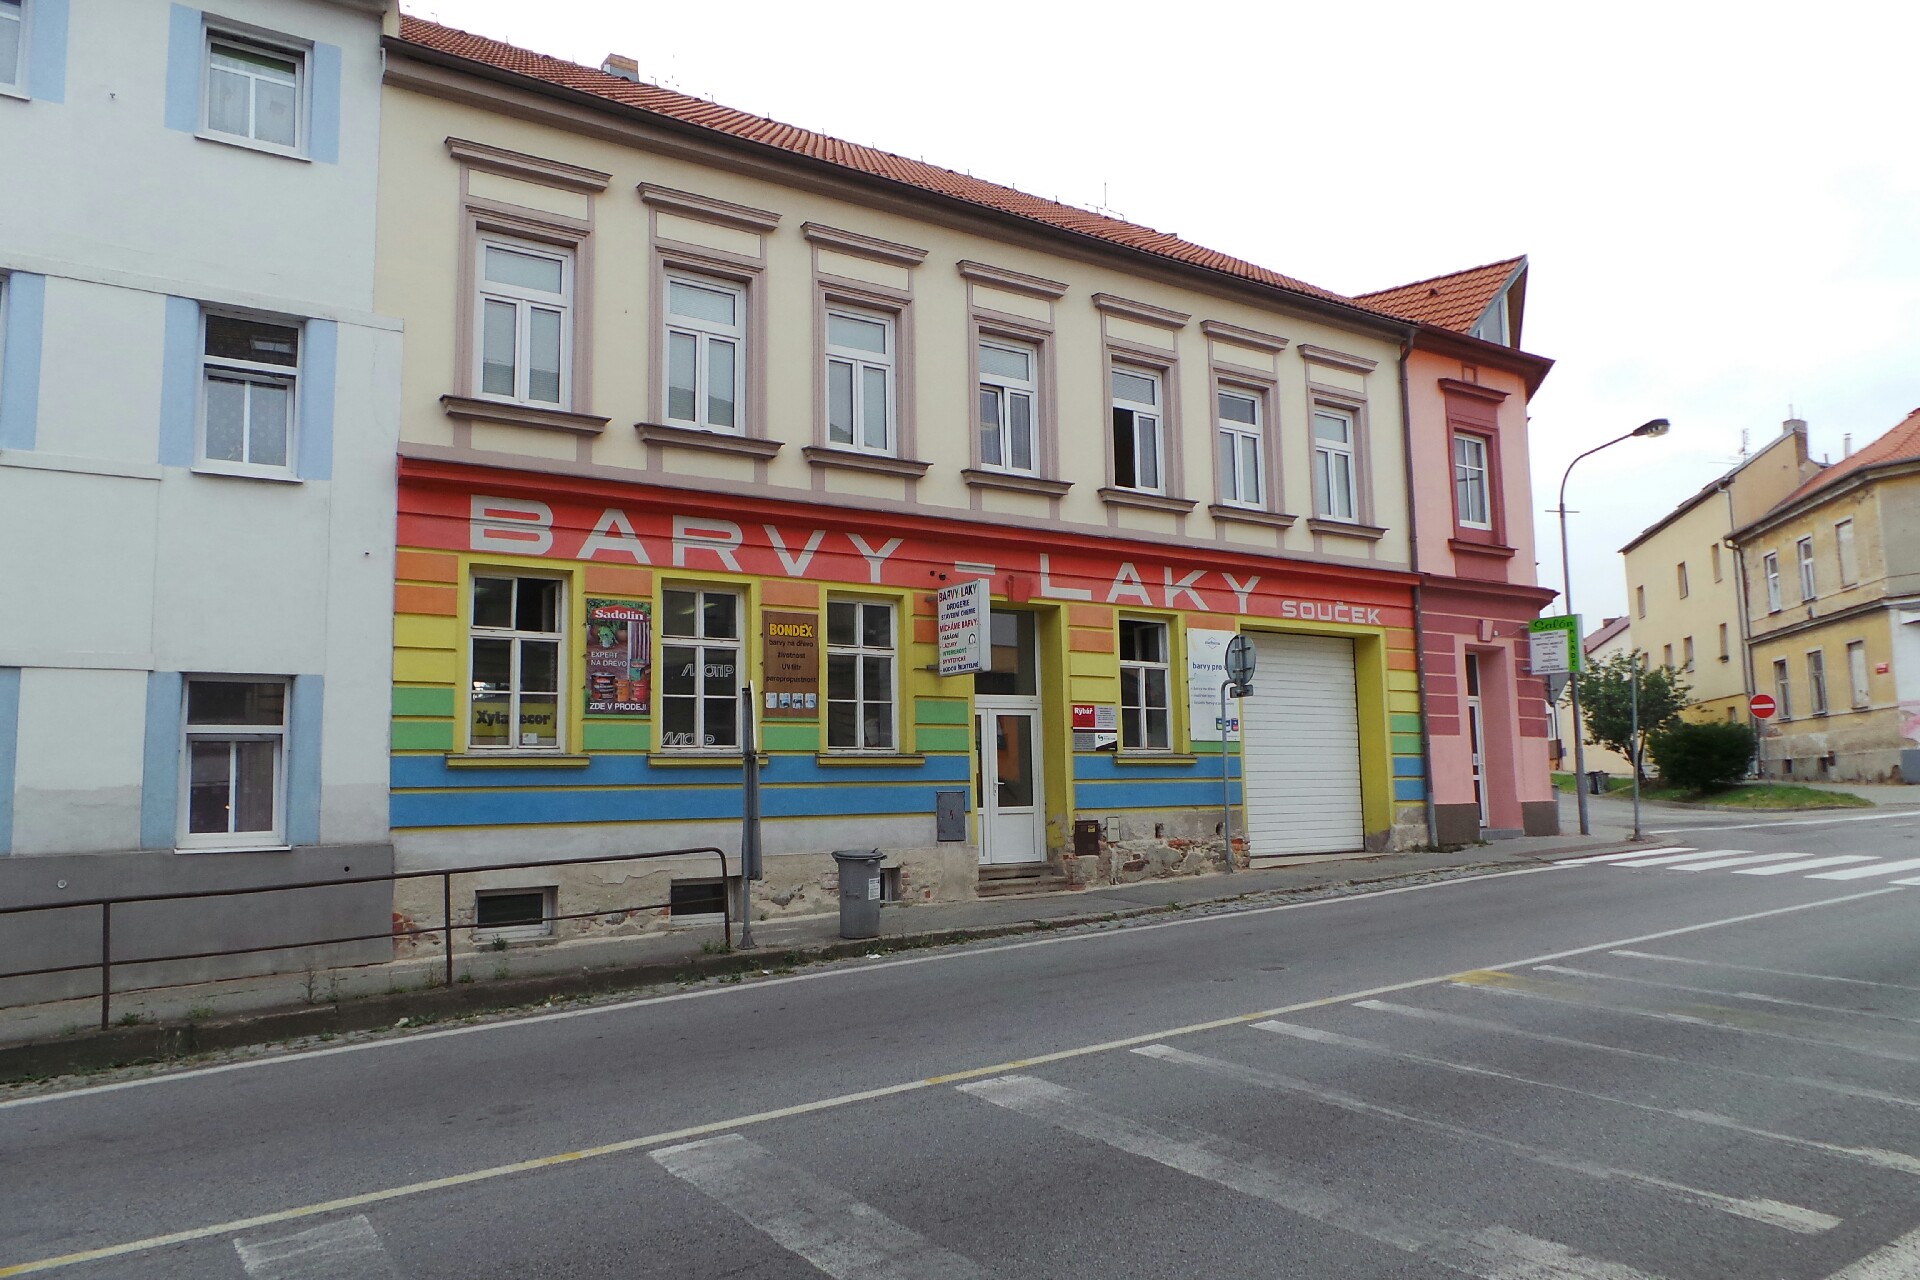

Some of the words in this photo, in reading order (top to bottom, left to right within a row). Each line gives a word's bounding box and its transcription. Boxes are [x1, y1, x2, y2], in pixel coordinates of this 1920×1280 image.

[470, 494, 904, 583] BARVY
[1040, 553, 1261, 613] LAKY
[946, 599, 970, 611] DROGERIE
[595, 609, 644, 621] Sadolin
[1281, 600, 1381, 625] SOUČEK
[769, 623, 814, 638] BONDEX
[1534, 619, 1573, 630] Salón
[591, 651, 618, 659] EXPERT
[1192, 662, 1210, 671] barvy
[1211, 664, 1222, 672] pro
[589, 702, 605, 710] ZDE
